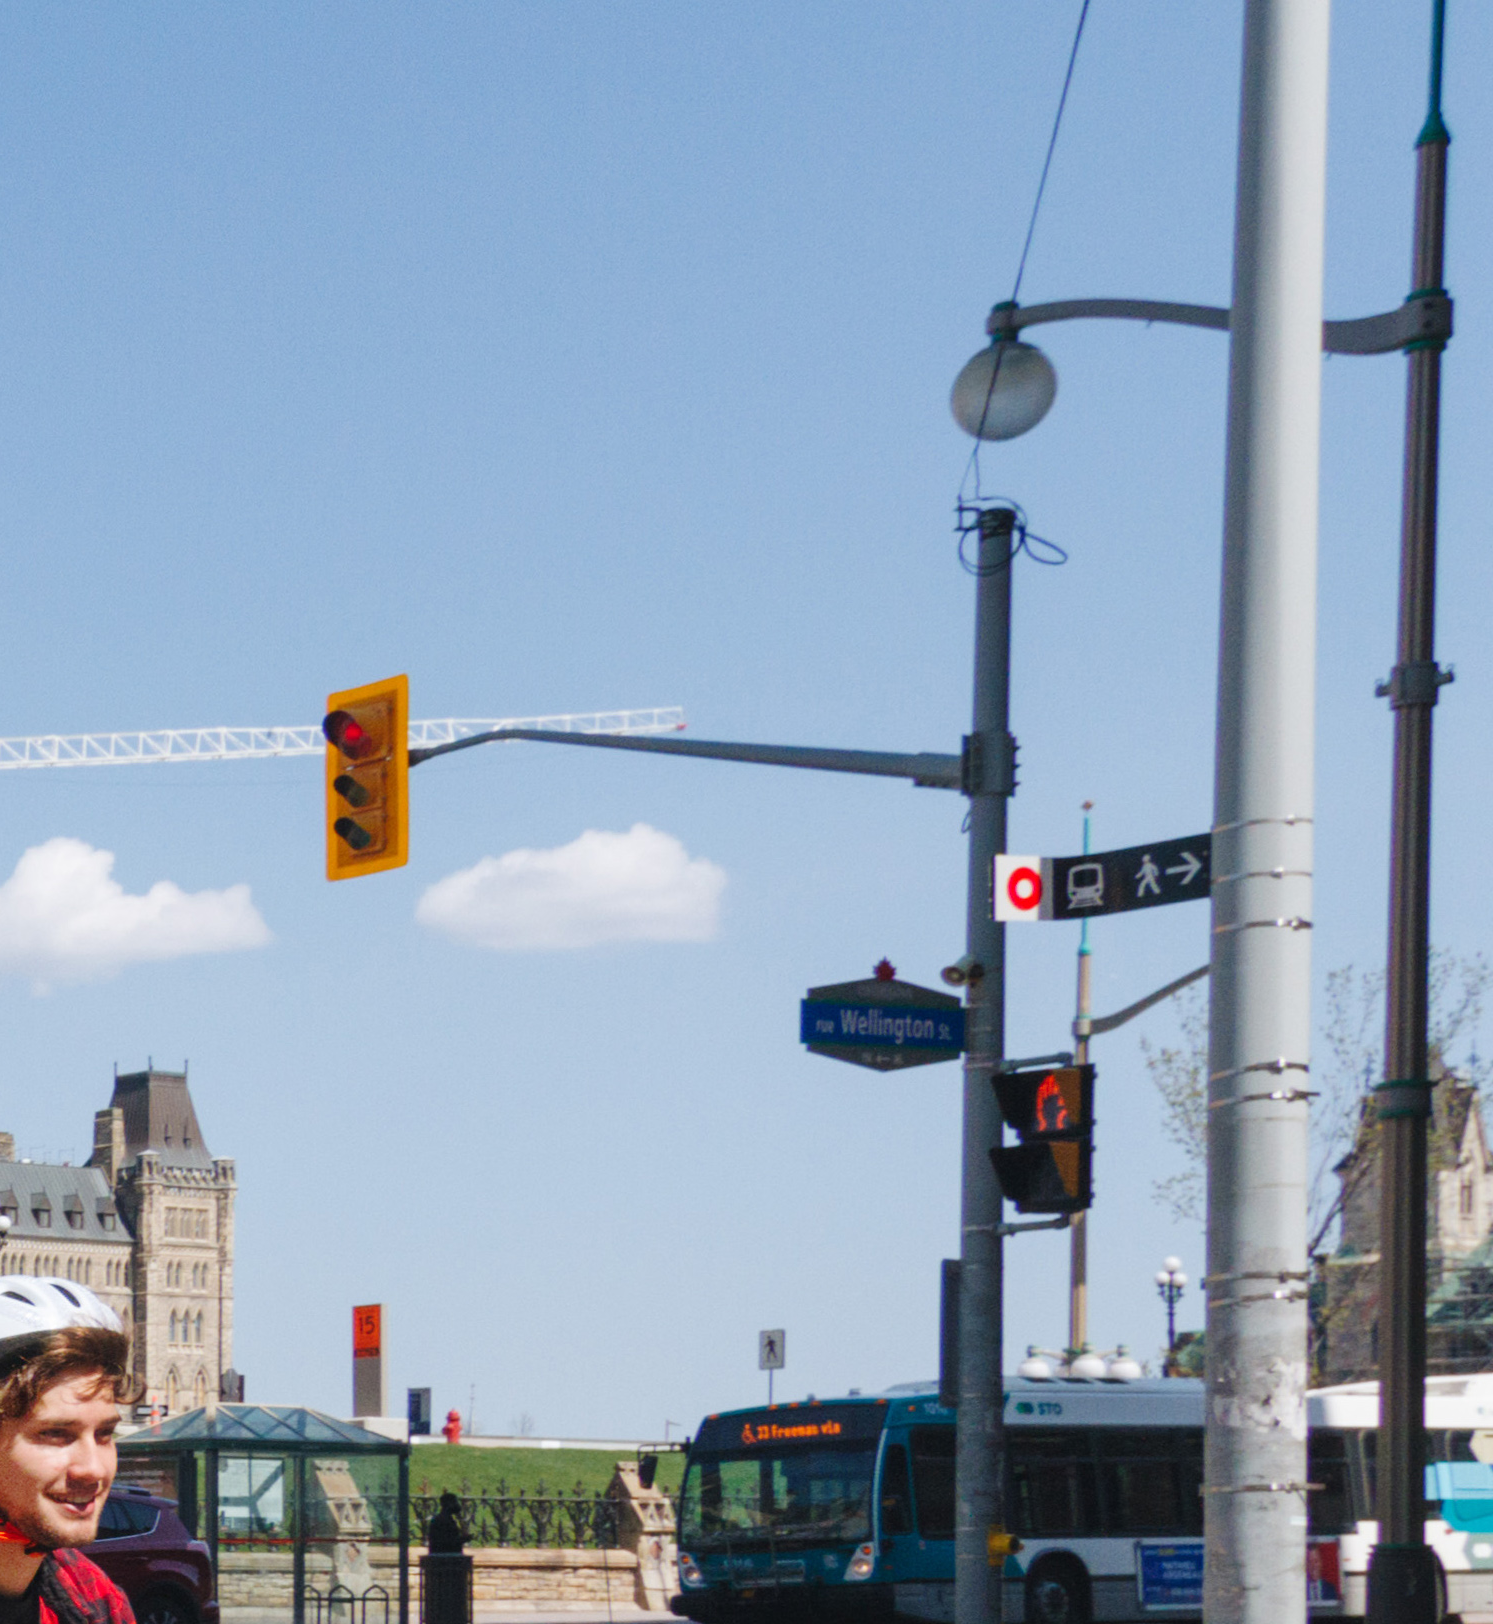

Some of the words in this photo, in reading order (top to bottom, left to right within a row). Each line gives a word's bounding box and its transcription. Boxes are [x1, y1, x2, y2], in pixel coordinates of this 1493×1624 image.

[815, 1018, 835, 1034] rue
[840, 1008, 935, 1045] Wellington
[359, 1315, 376, 1335] 15
[1038, 1402, 1063, 1415] STO
